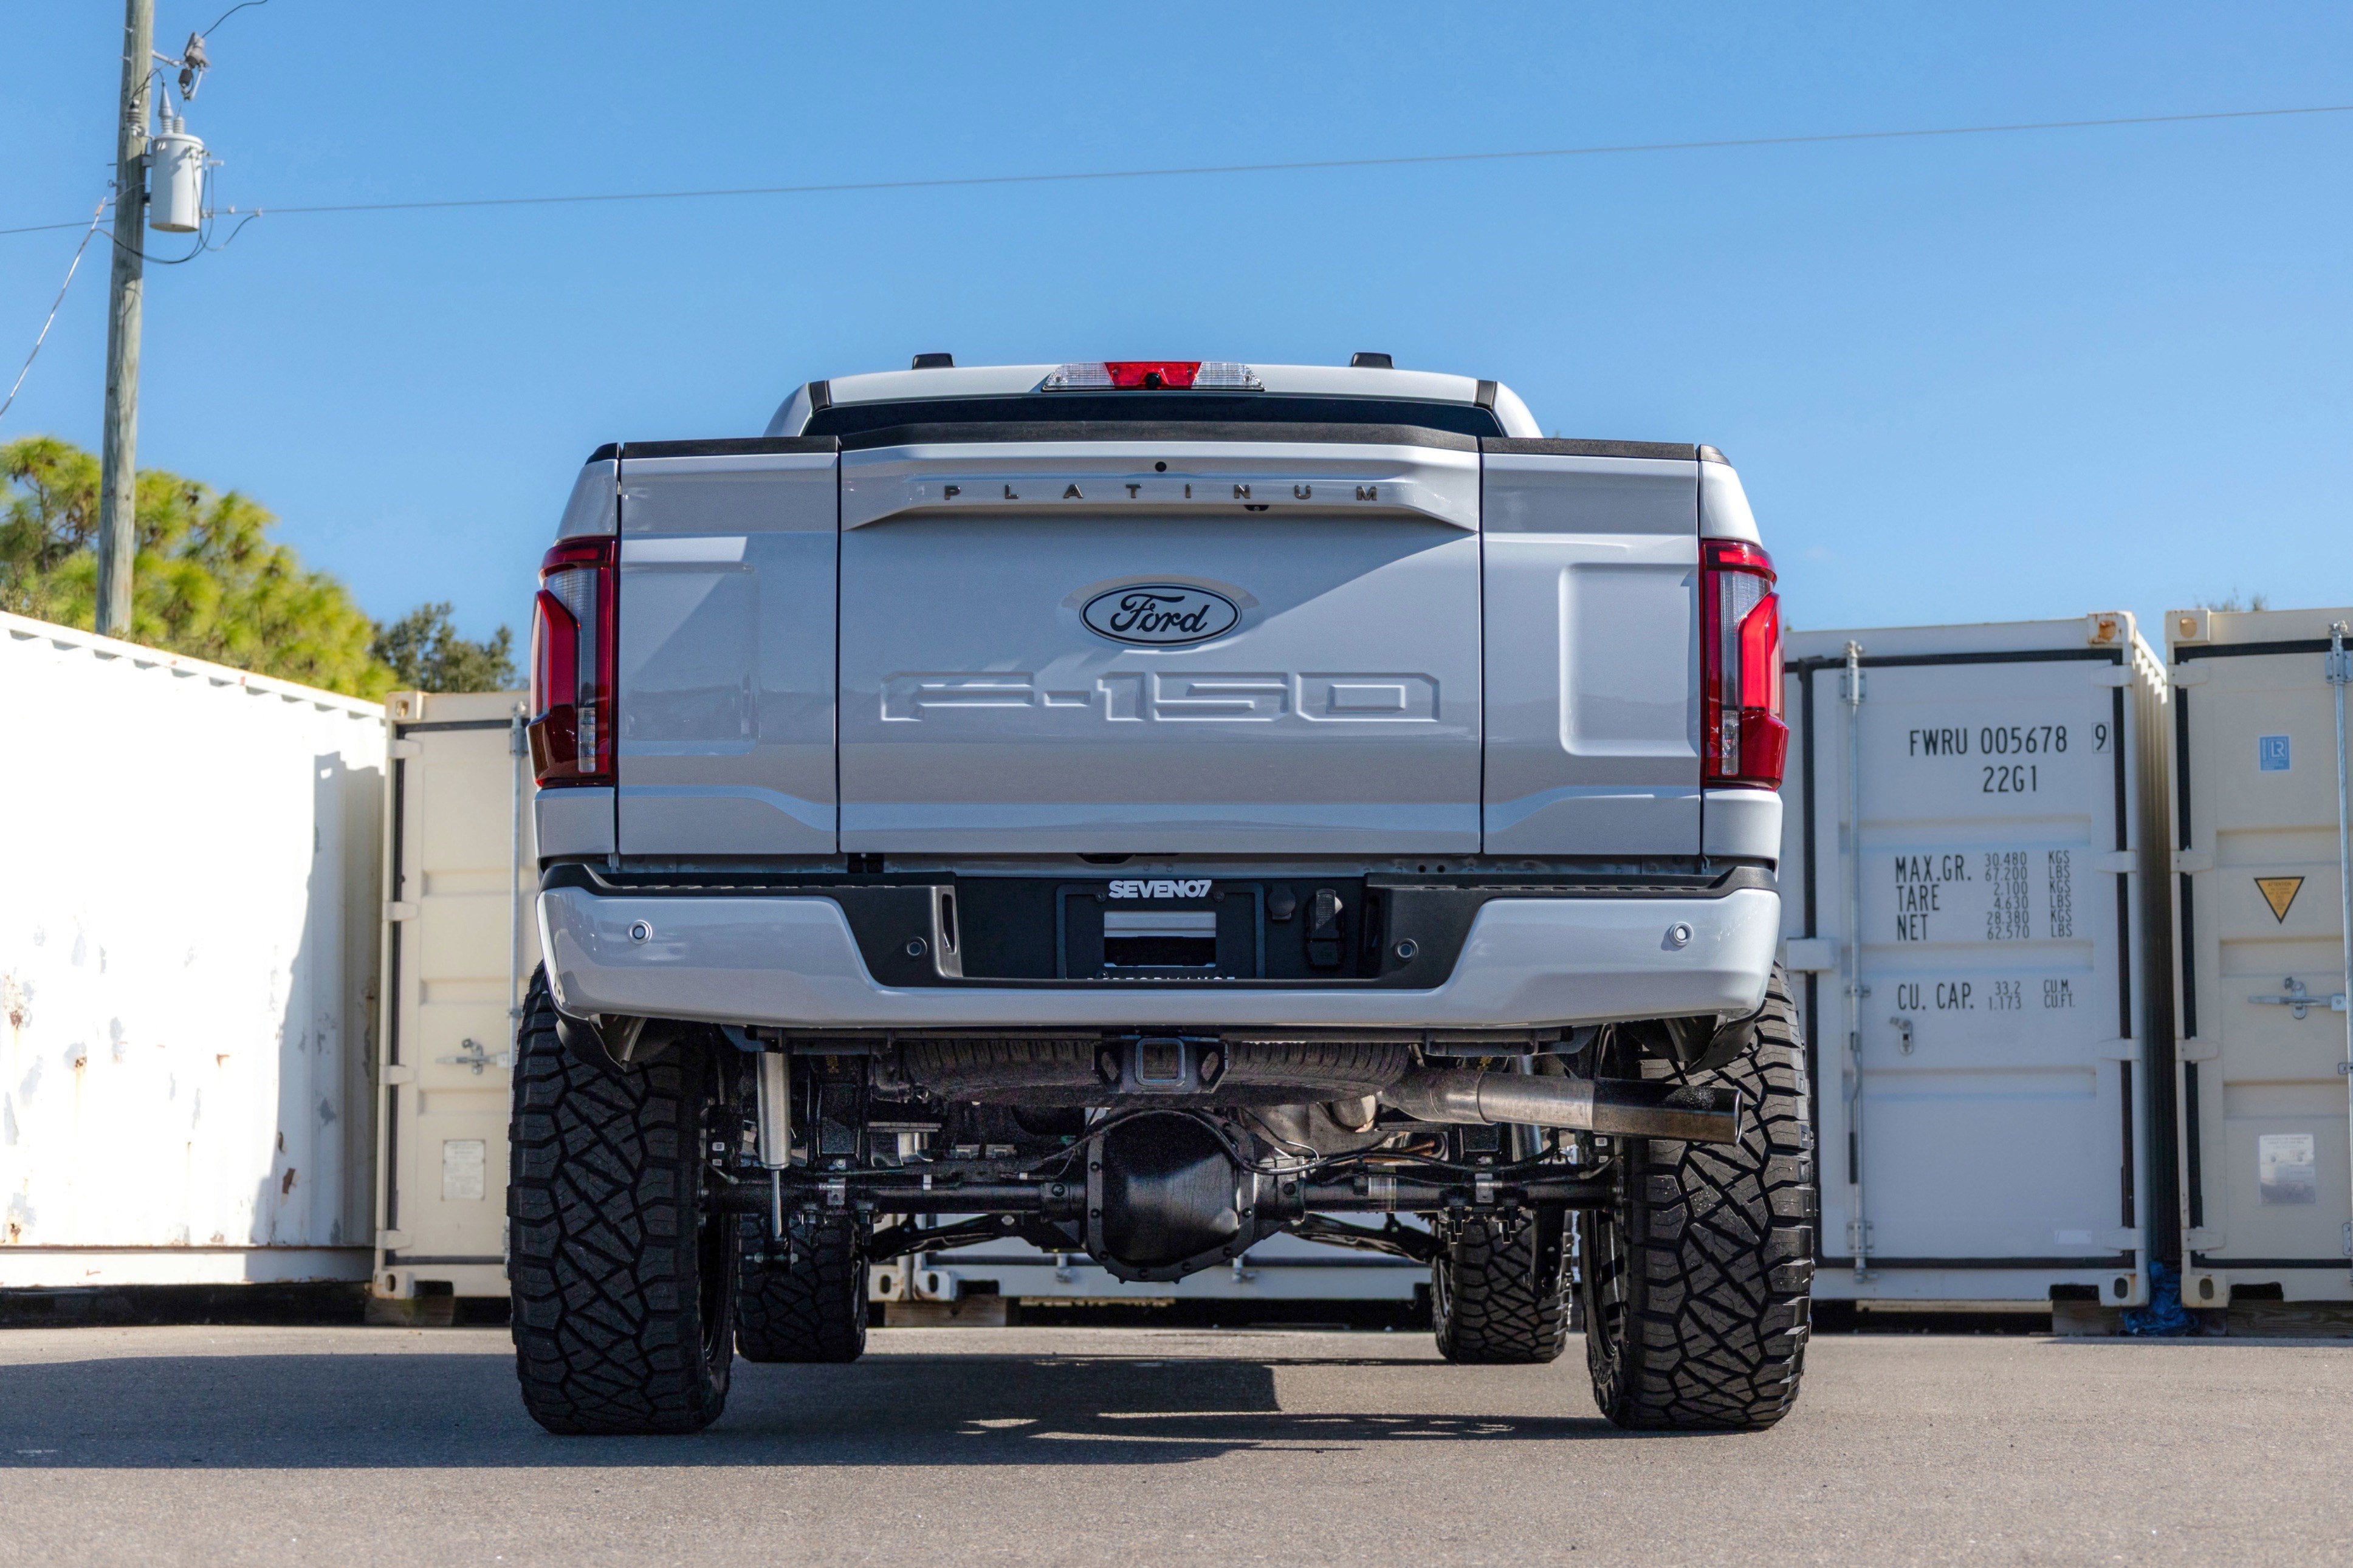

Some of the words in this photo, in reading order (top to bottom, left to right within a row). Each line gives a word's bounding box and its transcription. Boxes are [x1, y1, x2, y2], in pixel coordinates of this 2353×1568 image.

[943, 482, 1378, 502] PLATINUM
[1110, 593, 1211, 632] Ford
[879, 671, 1440, 722] F-150
[1909, 728, 1968, 756] FWRU
[1980, 725, 2067, 754] 005678
[2095, 724, 2107, 751] 9
[1983, 765, 2037, 792] 22G1
[1895, 855, 1972, 882] MAX.GR.
[1984, 851, 2027, 868] 30.480
[2049, 850, 2070, 864] KGS
[1985, 866, 2028, 882] 67.200
[2049, 865, 2070, 879] LBS
[1895, 885, 1940, 911] TARE
[1993, 881, 2028, 896] 2.100
[2049, 879, 2071, 894] KGS
[1994, 895, 2028, 910] 4.630
[2050, 894, 2072, 908] LBS
[1897, 914, 1928, 941] NET
[1987, 911, 2030, 926] 28.380
[2050, 908, 2072, 923] KGS
[1987, 925, 2030, 940] 62.570
[2050, 923, 2073, 937] LBS
[1897, 984, 1926, 1010] CU.
[1936, 982, 1974, 1010] CAP.
[1994, 980, 2022, 996] 33.2
[1988, 995, 2022, 1012] 1.173
